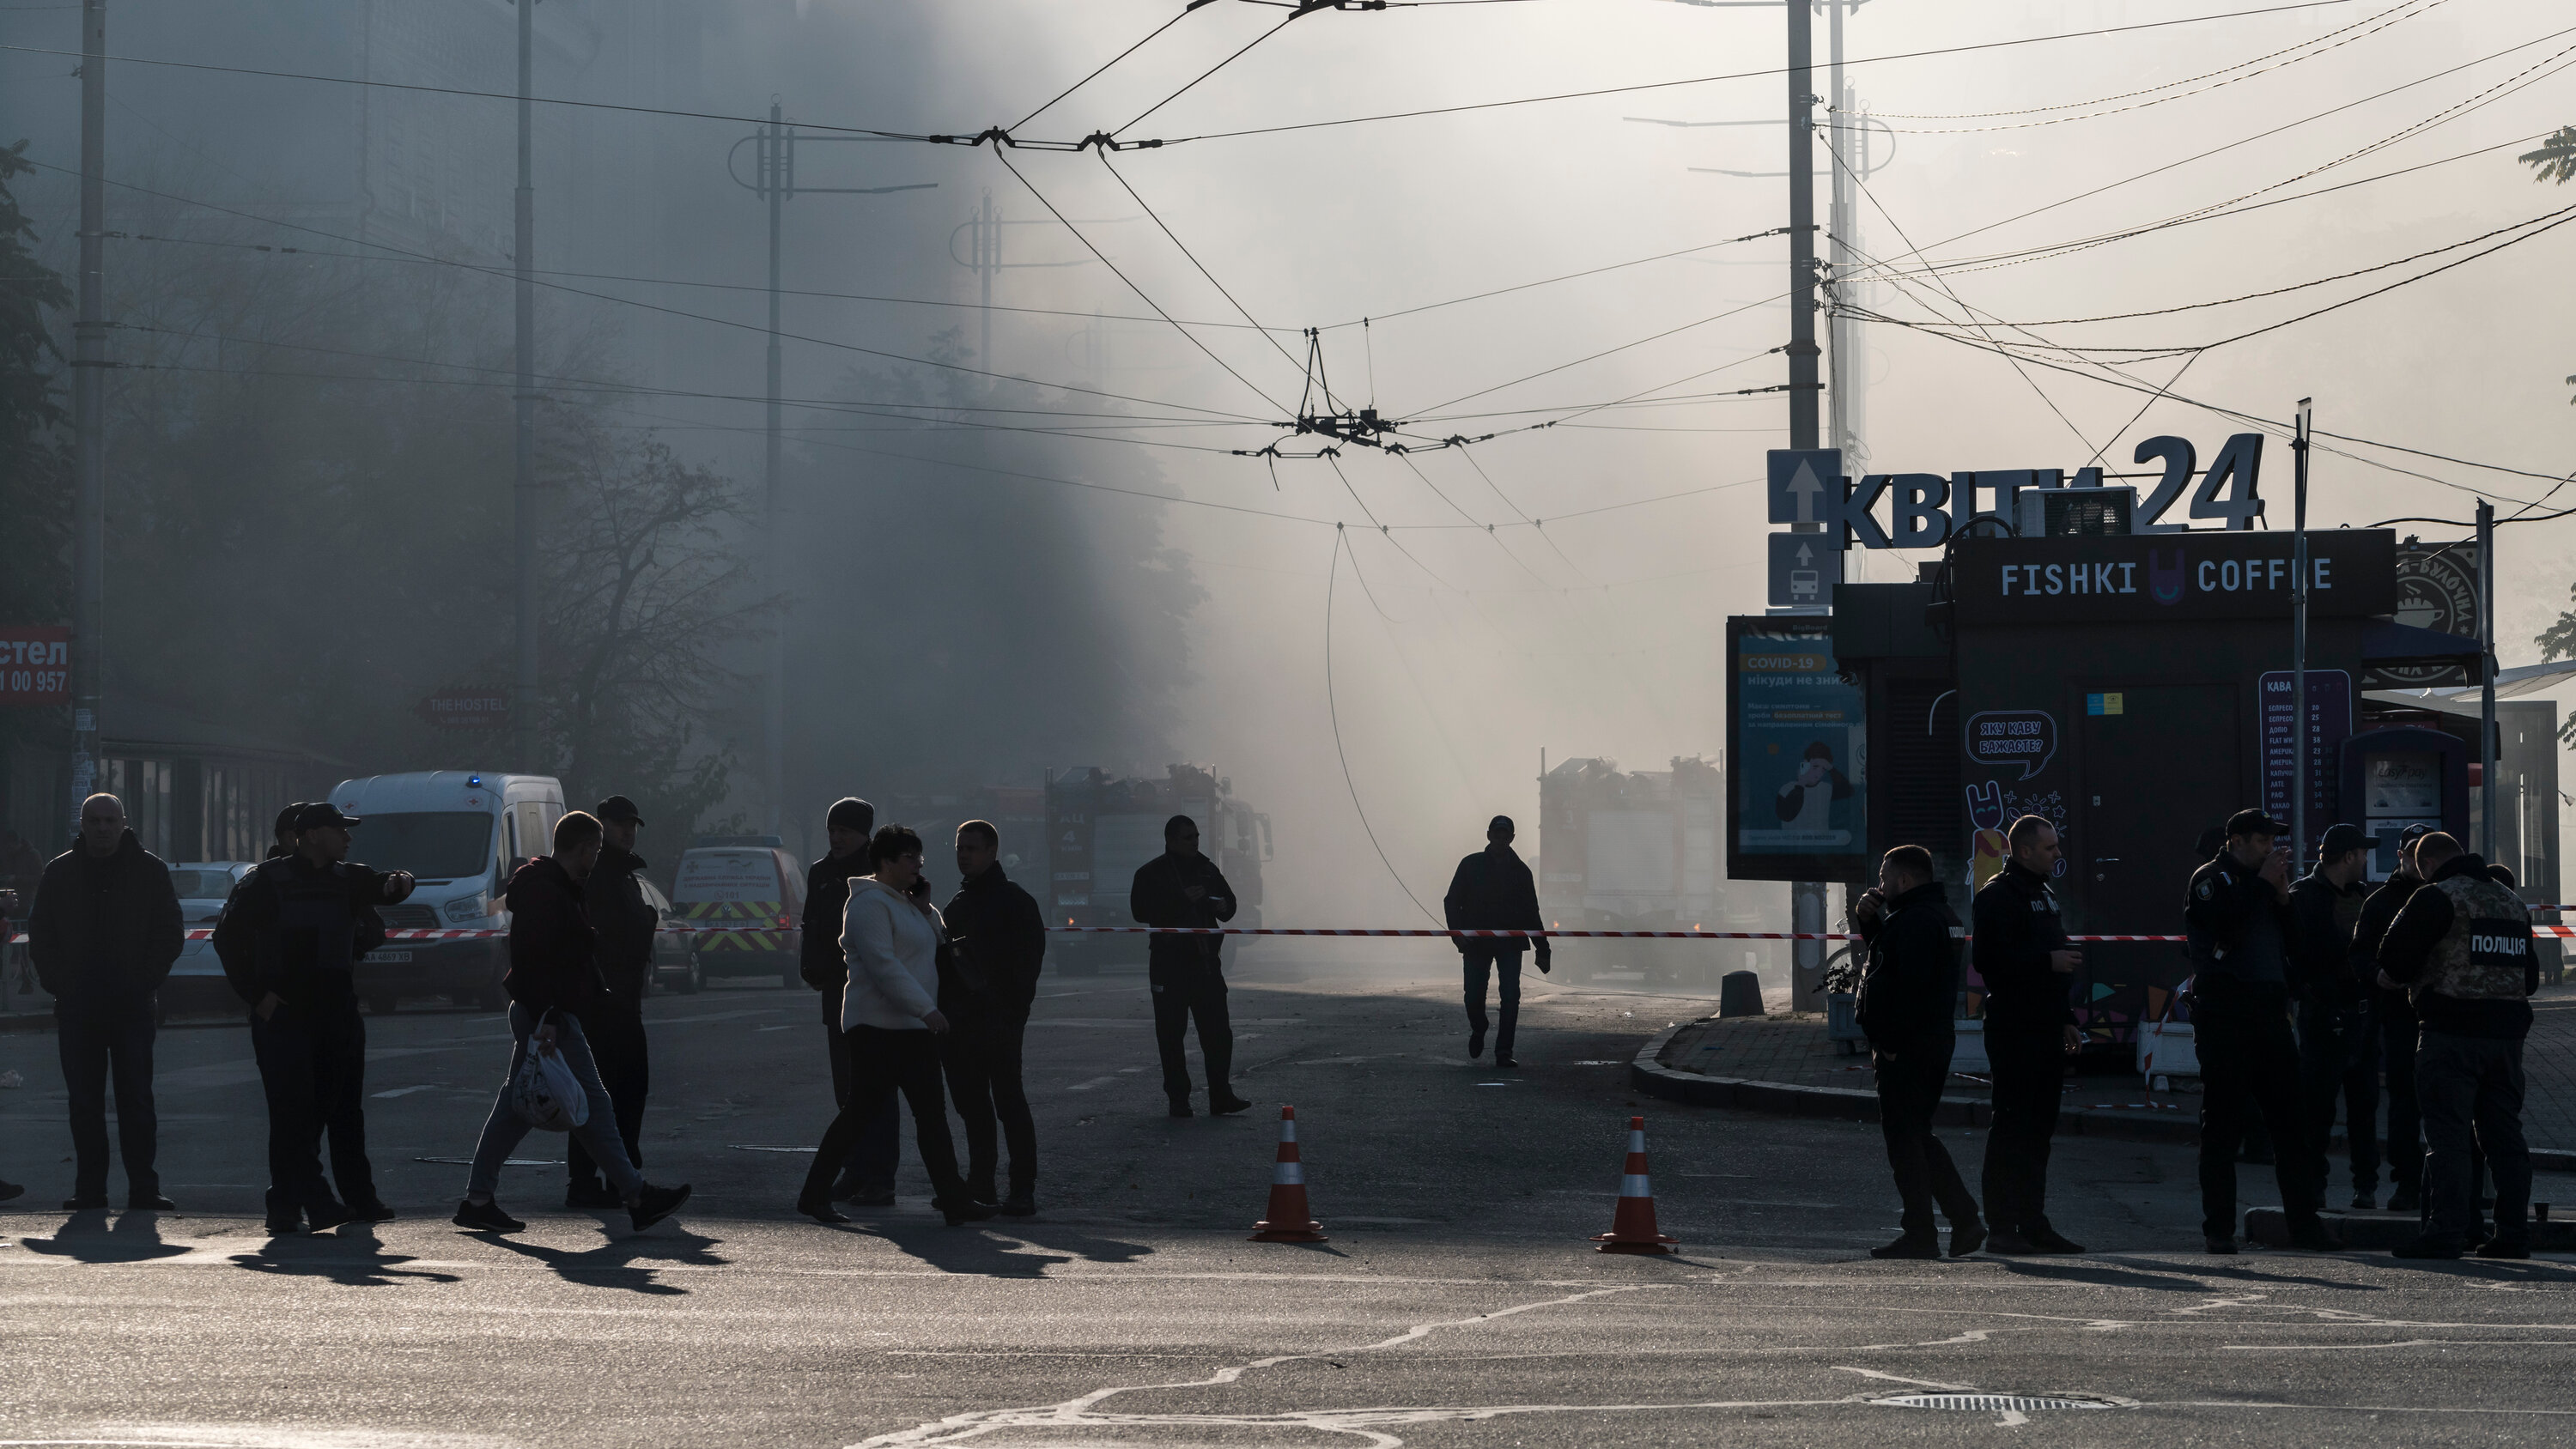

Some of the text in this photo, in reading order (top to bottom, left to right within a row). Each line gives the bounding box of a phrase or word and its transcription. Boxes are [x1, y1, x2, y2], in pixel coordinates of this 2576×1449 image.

[2135, 433, 2265, 532] 24
[2002, 562, 2136, 596] FISHKI
[2397, 558, 2474, 622] Я-БУЛОЧНА
[1747, 658, 1814, 669] COVID-19
[11, 670, 31, 692] 00
[37, 670, 67, 692] 957
[1748, 675, 1846, 687] нікуди не зни
[2267, 682, 2292, 693] КАВА
[430, 698, 507, 711] THE HOSTEL
[1980, 721, 2041, 736] ЯКУ КАВУ
[1979, 739, 2043, 754] БАЖАЄТЕ?
[1062, 829, 1076, 842] 4
[2472, 935, 2526, 955] ПОЛІЦІЯ
